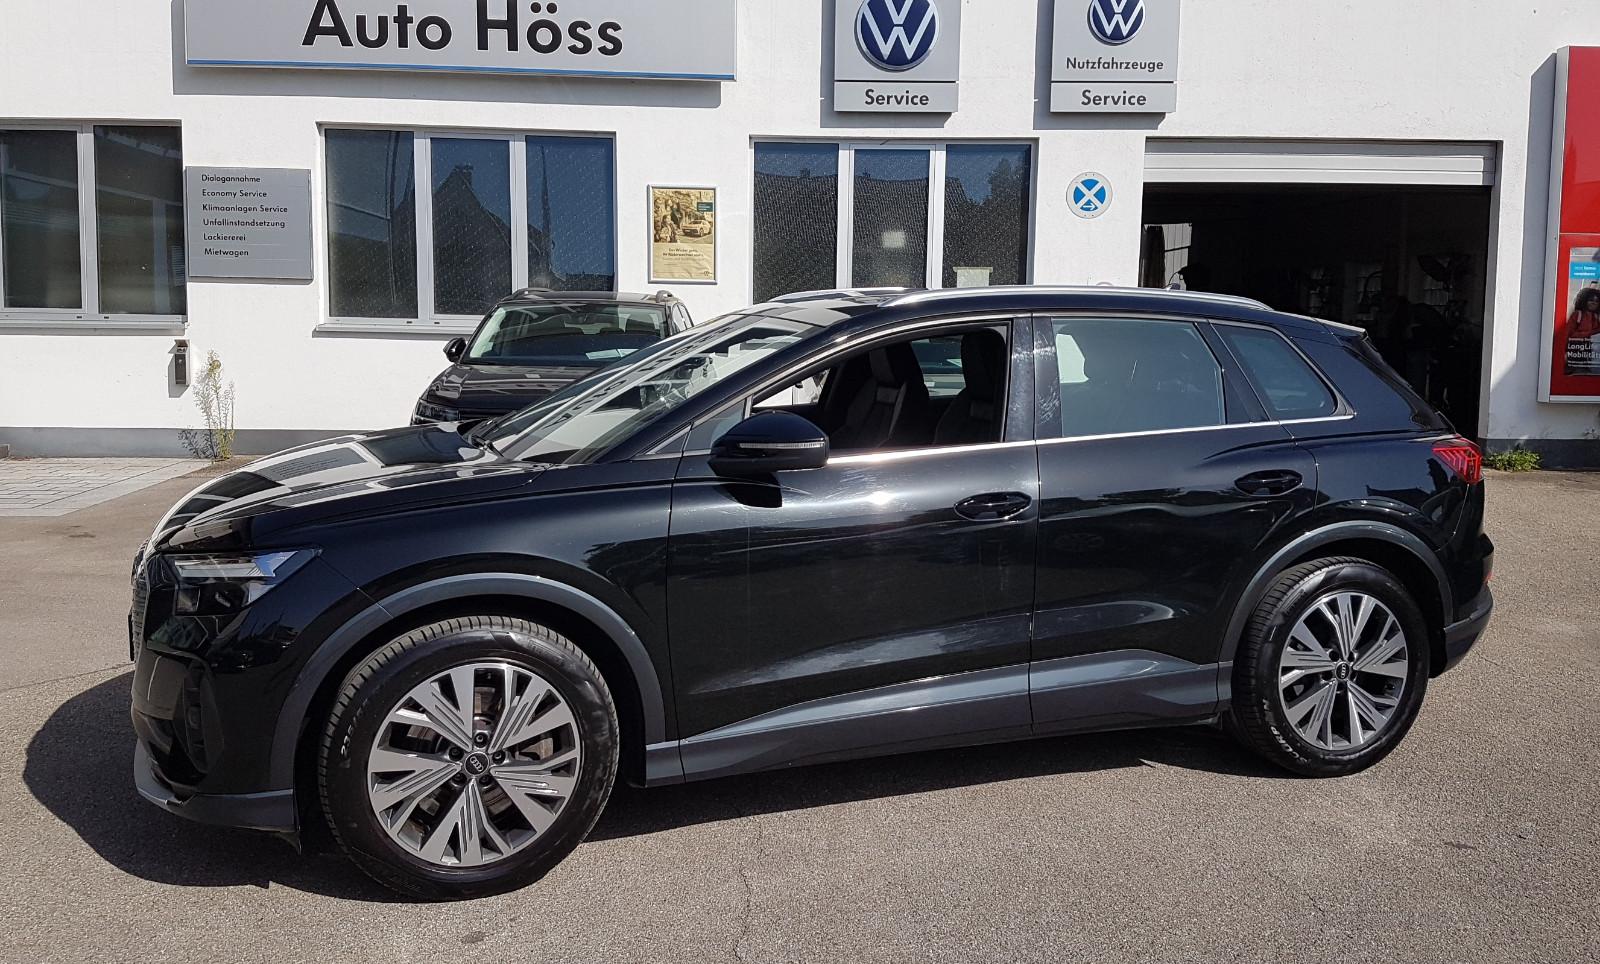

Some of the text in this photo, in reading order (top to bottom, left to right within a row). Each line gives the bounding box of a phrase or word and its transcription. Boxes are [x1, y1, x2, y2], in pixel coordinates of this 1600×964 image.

[301, 0, 624, 56] Auto Höss
[1066, 56, 1164, 73] Nutzfahrzeuge
[864, 88, 930, 106] Service
[1081, 89, 1147, 106] Service
[201, 174, 261, 183] Dialogannahme
[202, 188, 268, 198] Economy Service
[202, 203, 288, 214] Klimaanlagen Service
[203, 218, 286, 228] Unfallinstandsetzung
[203, 233, 246, 241] Lackiererei
[204, 247, 249, 257] Mietwagen
[1567, 351, 1600, 359] Mobilität
